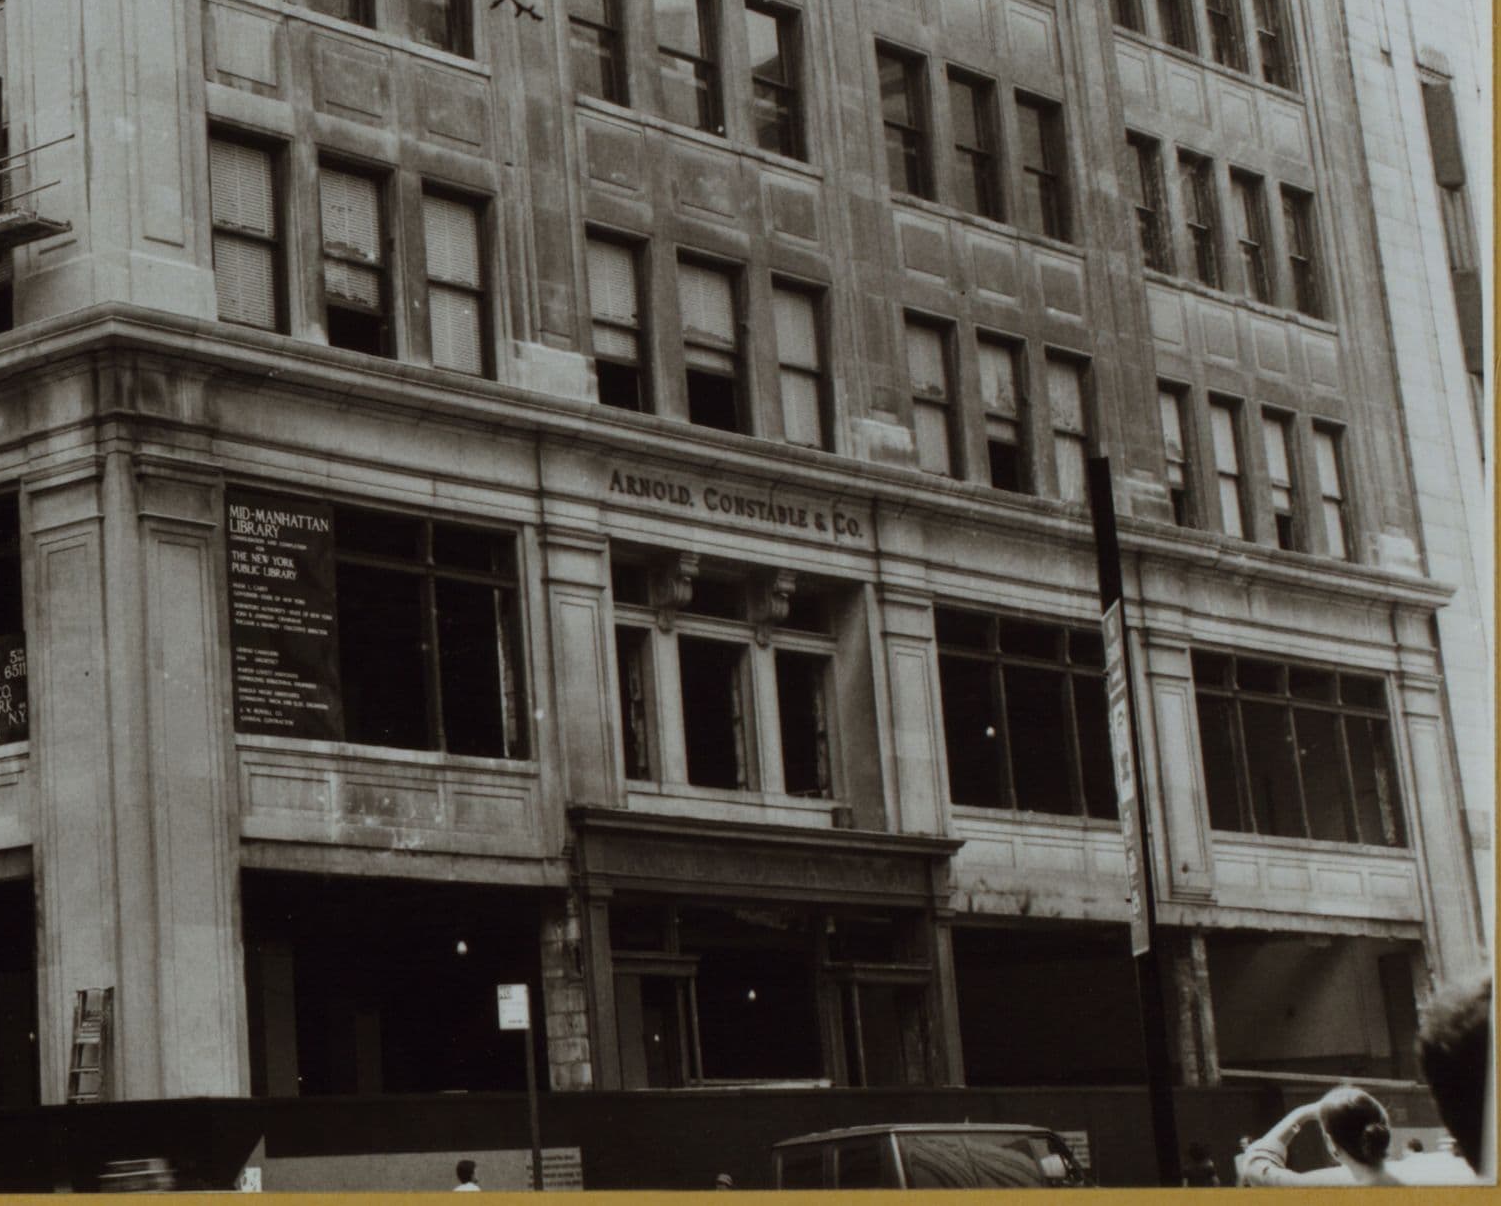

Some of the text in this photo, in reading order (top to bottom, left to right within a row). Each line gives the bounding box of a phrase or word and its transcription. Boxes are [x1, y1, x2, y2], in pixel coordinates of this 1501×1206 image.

[229, 504, 329, 532] MID-MANHATTAN
[702, 487, 808, 528] CONSTABLE
[814, 512, 828, 532] &
[833, 512, 863, 538] CO.
[229, 518, 280, 539] LIBRARY
[231, 550, 295, 569] THE NEW YORK
[231, 562, 297, 580] PUBLIC LIBRARY
